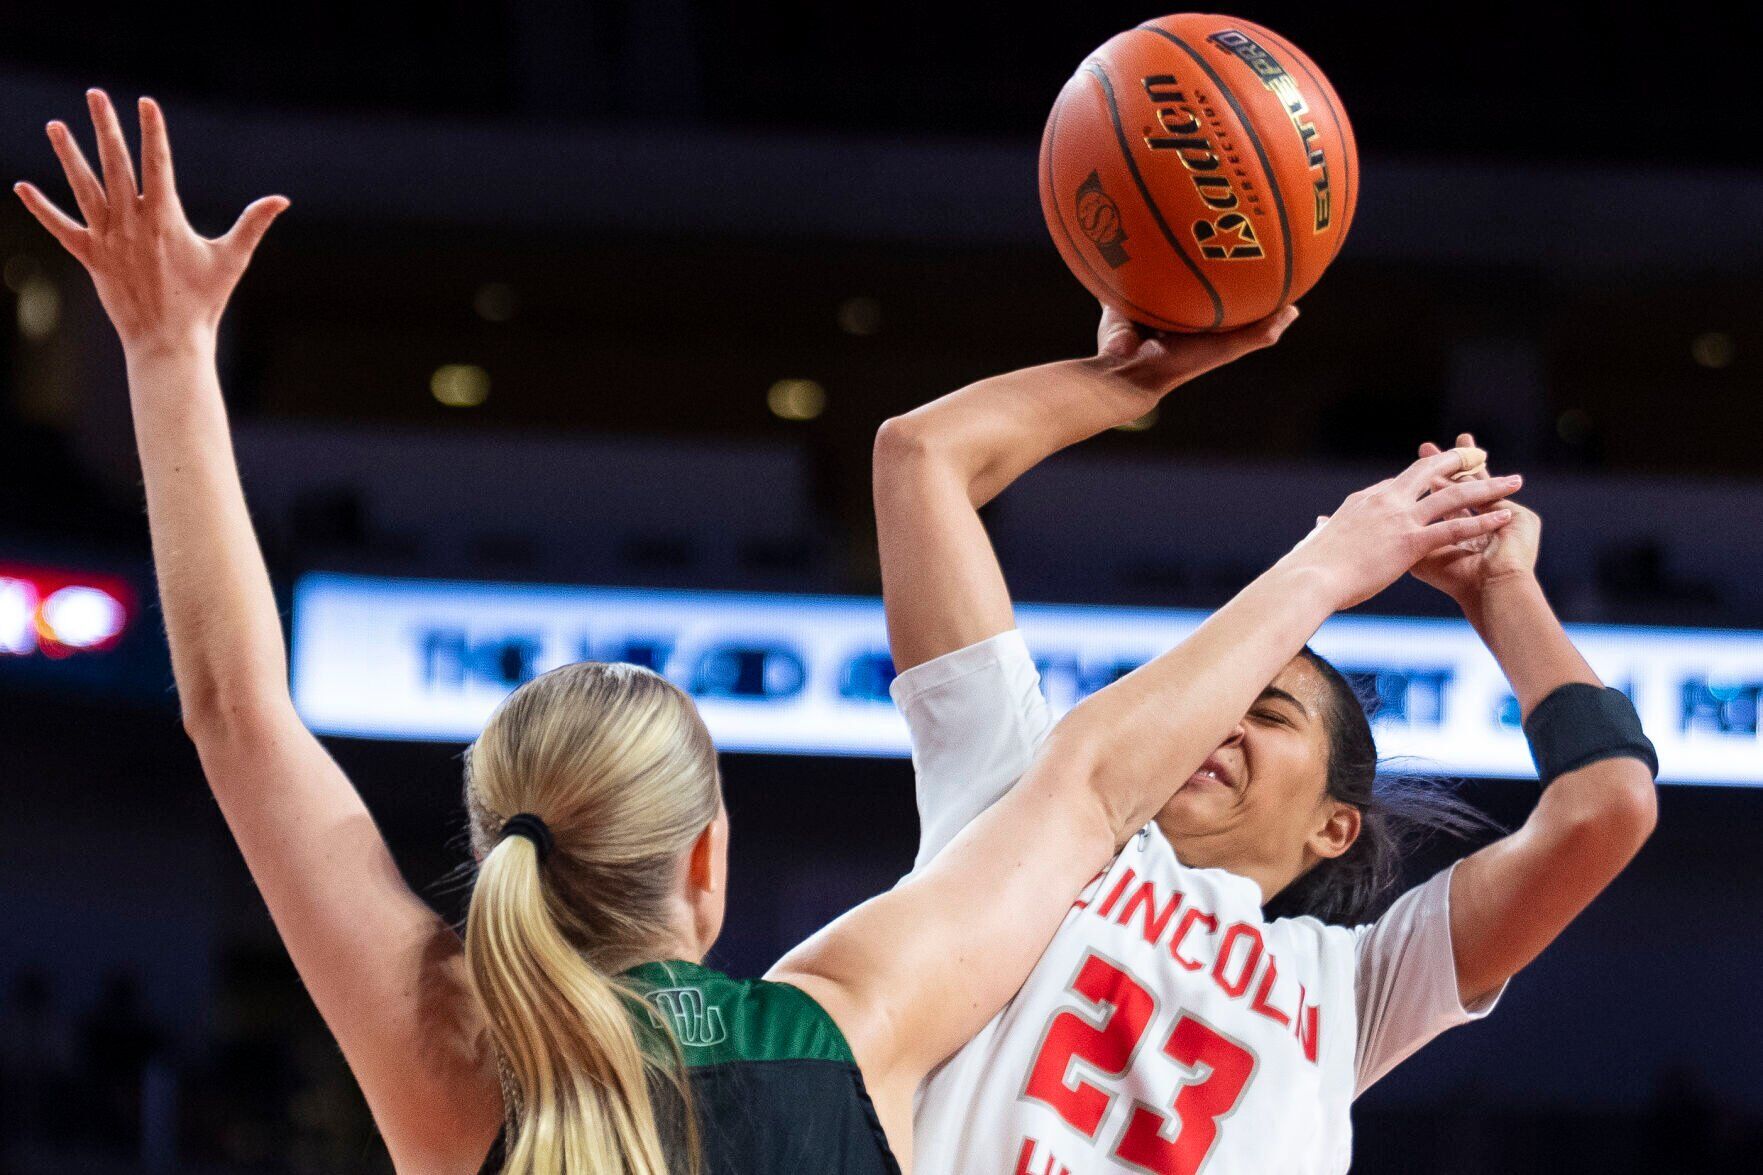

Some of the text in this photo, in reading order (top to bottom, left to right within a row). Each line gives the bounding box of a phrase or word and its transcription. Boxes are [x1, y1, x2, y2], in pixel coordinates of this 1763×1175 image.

[1141, 74, 1265, 260] Baden
[1016, 945, 1260, 1175] 23
[1072, 865, 1320, 1066] INCOLN
